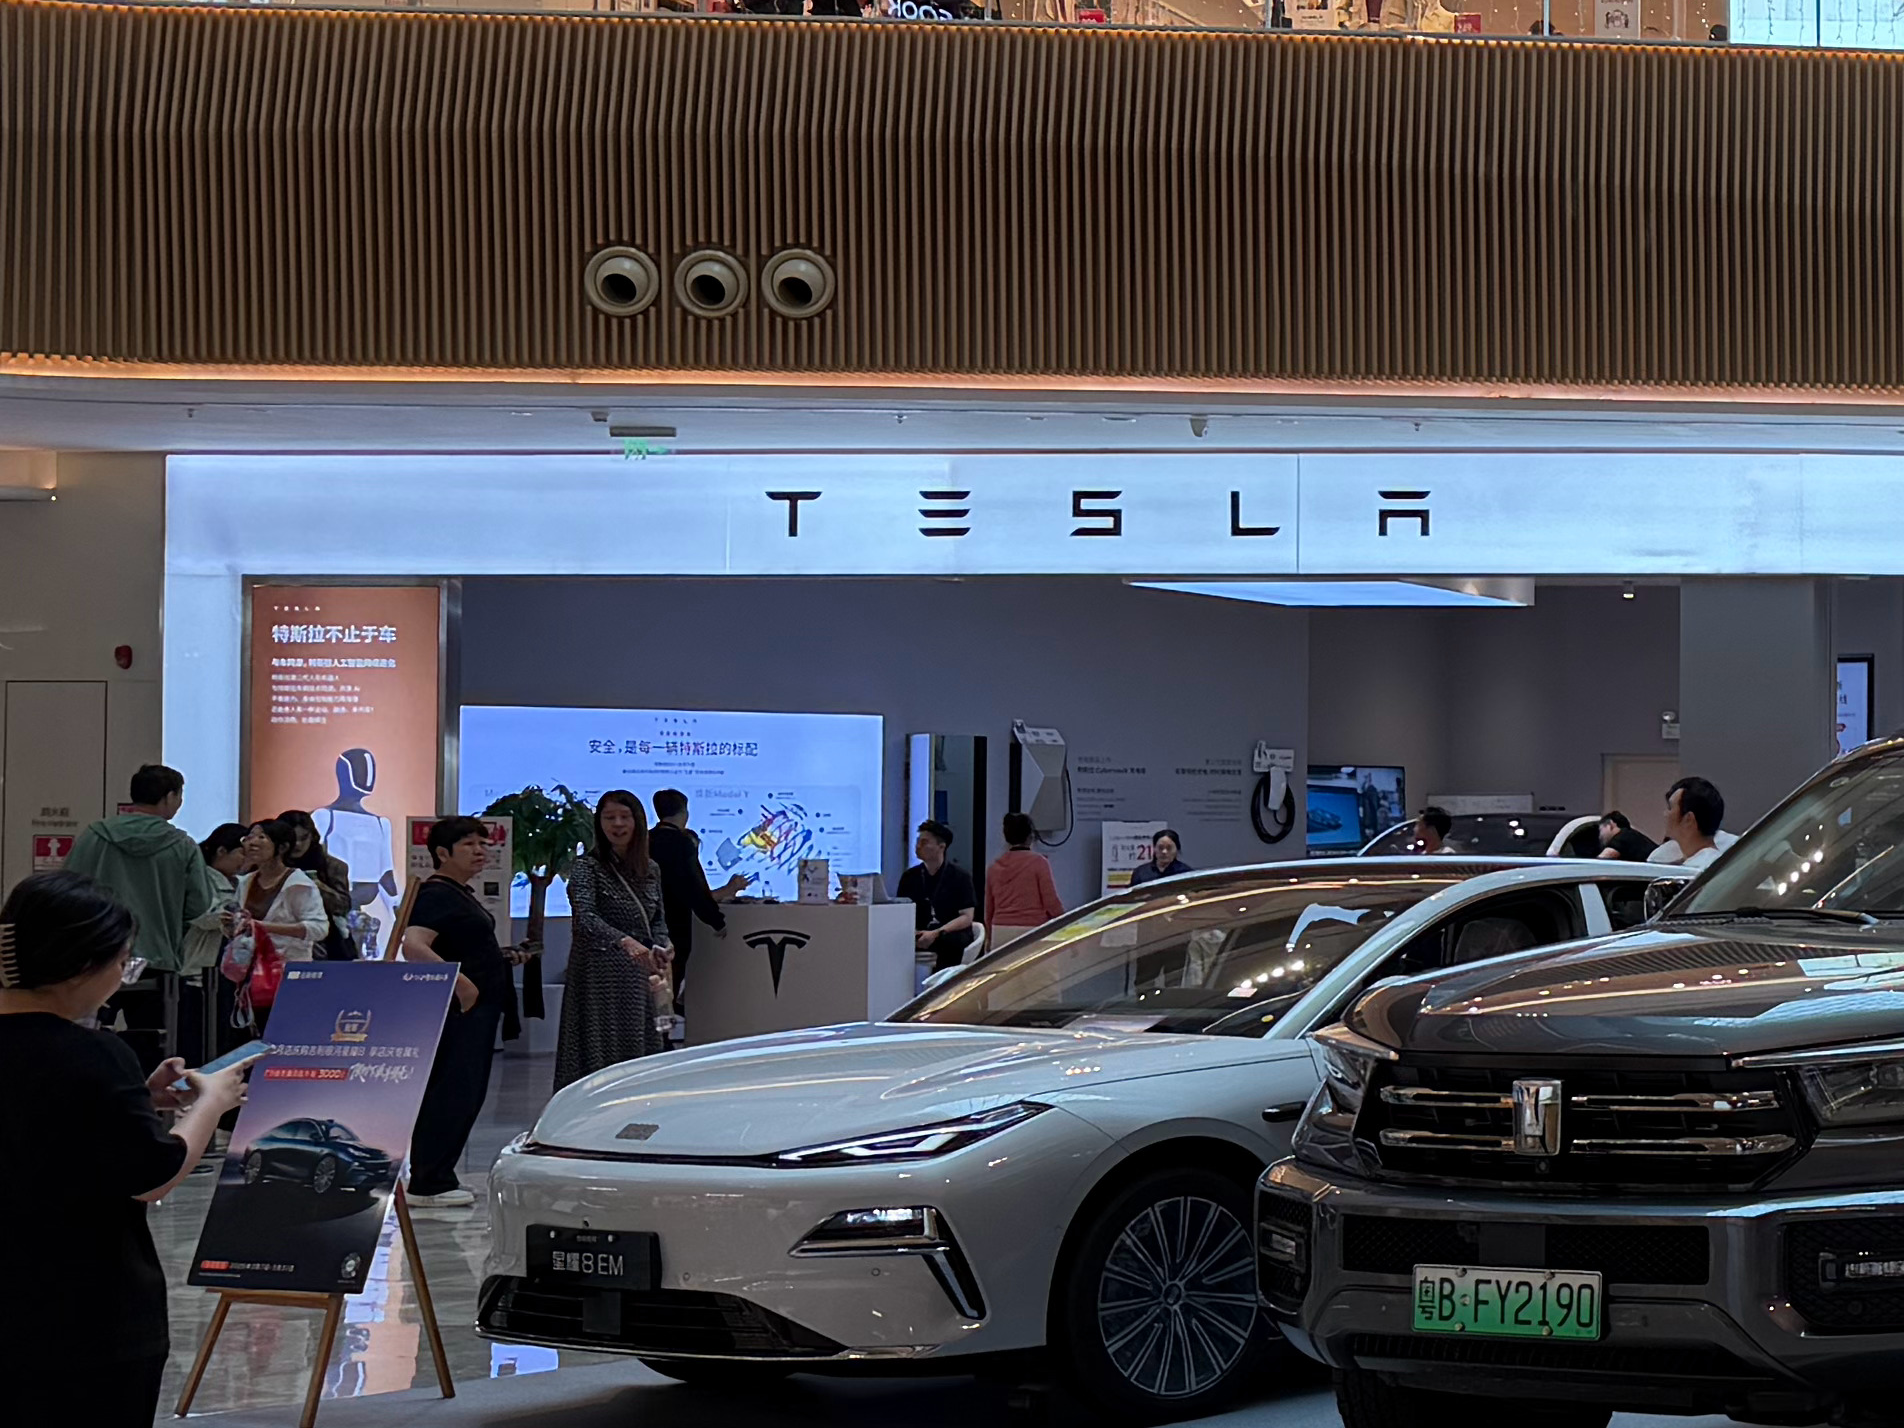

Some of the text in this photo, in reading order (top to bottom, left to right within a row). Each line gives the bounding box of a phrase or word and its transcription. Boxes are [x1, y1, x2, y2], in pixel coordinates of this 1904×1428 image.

[765, 489, 1431, 538] TESLA
[271, 624, 397, 643] 特斯拉不止于车
[598, 1255, 624, 1277] EM
